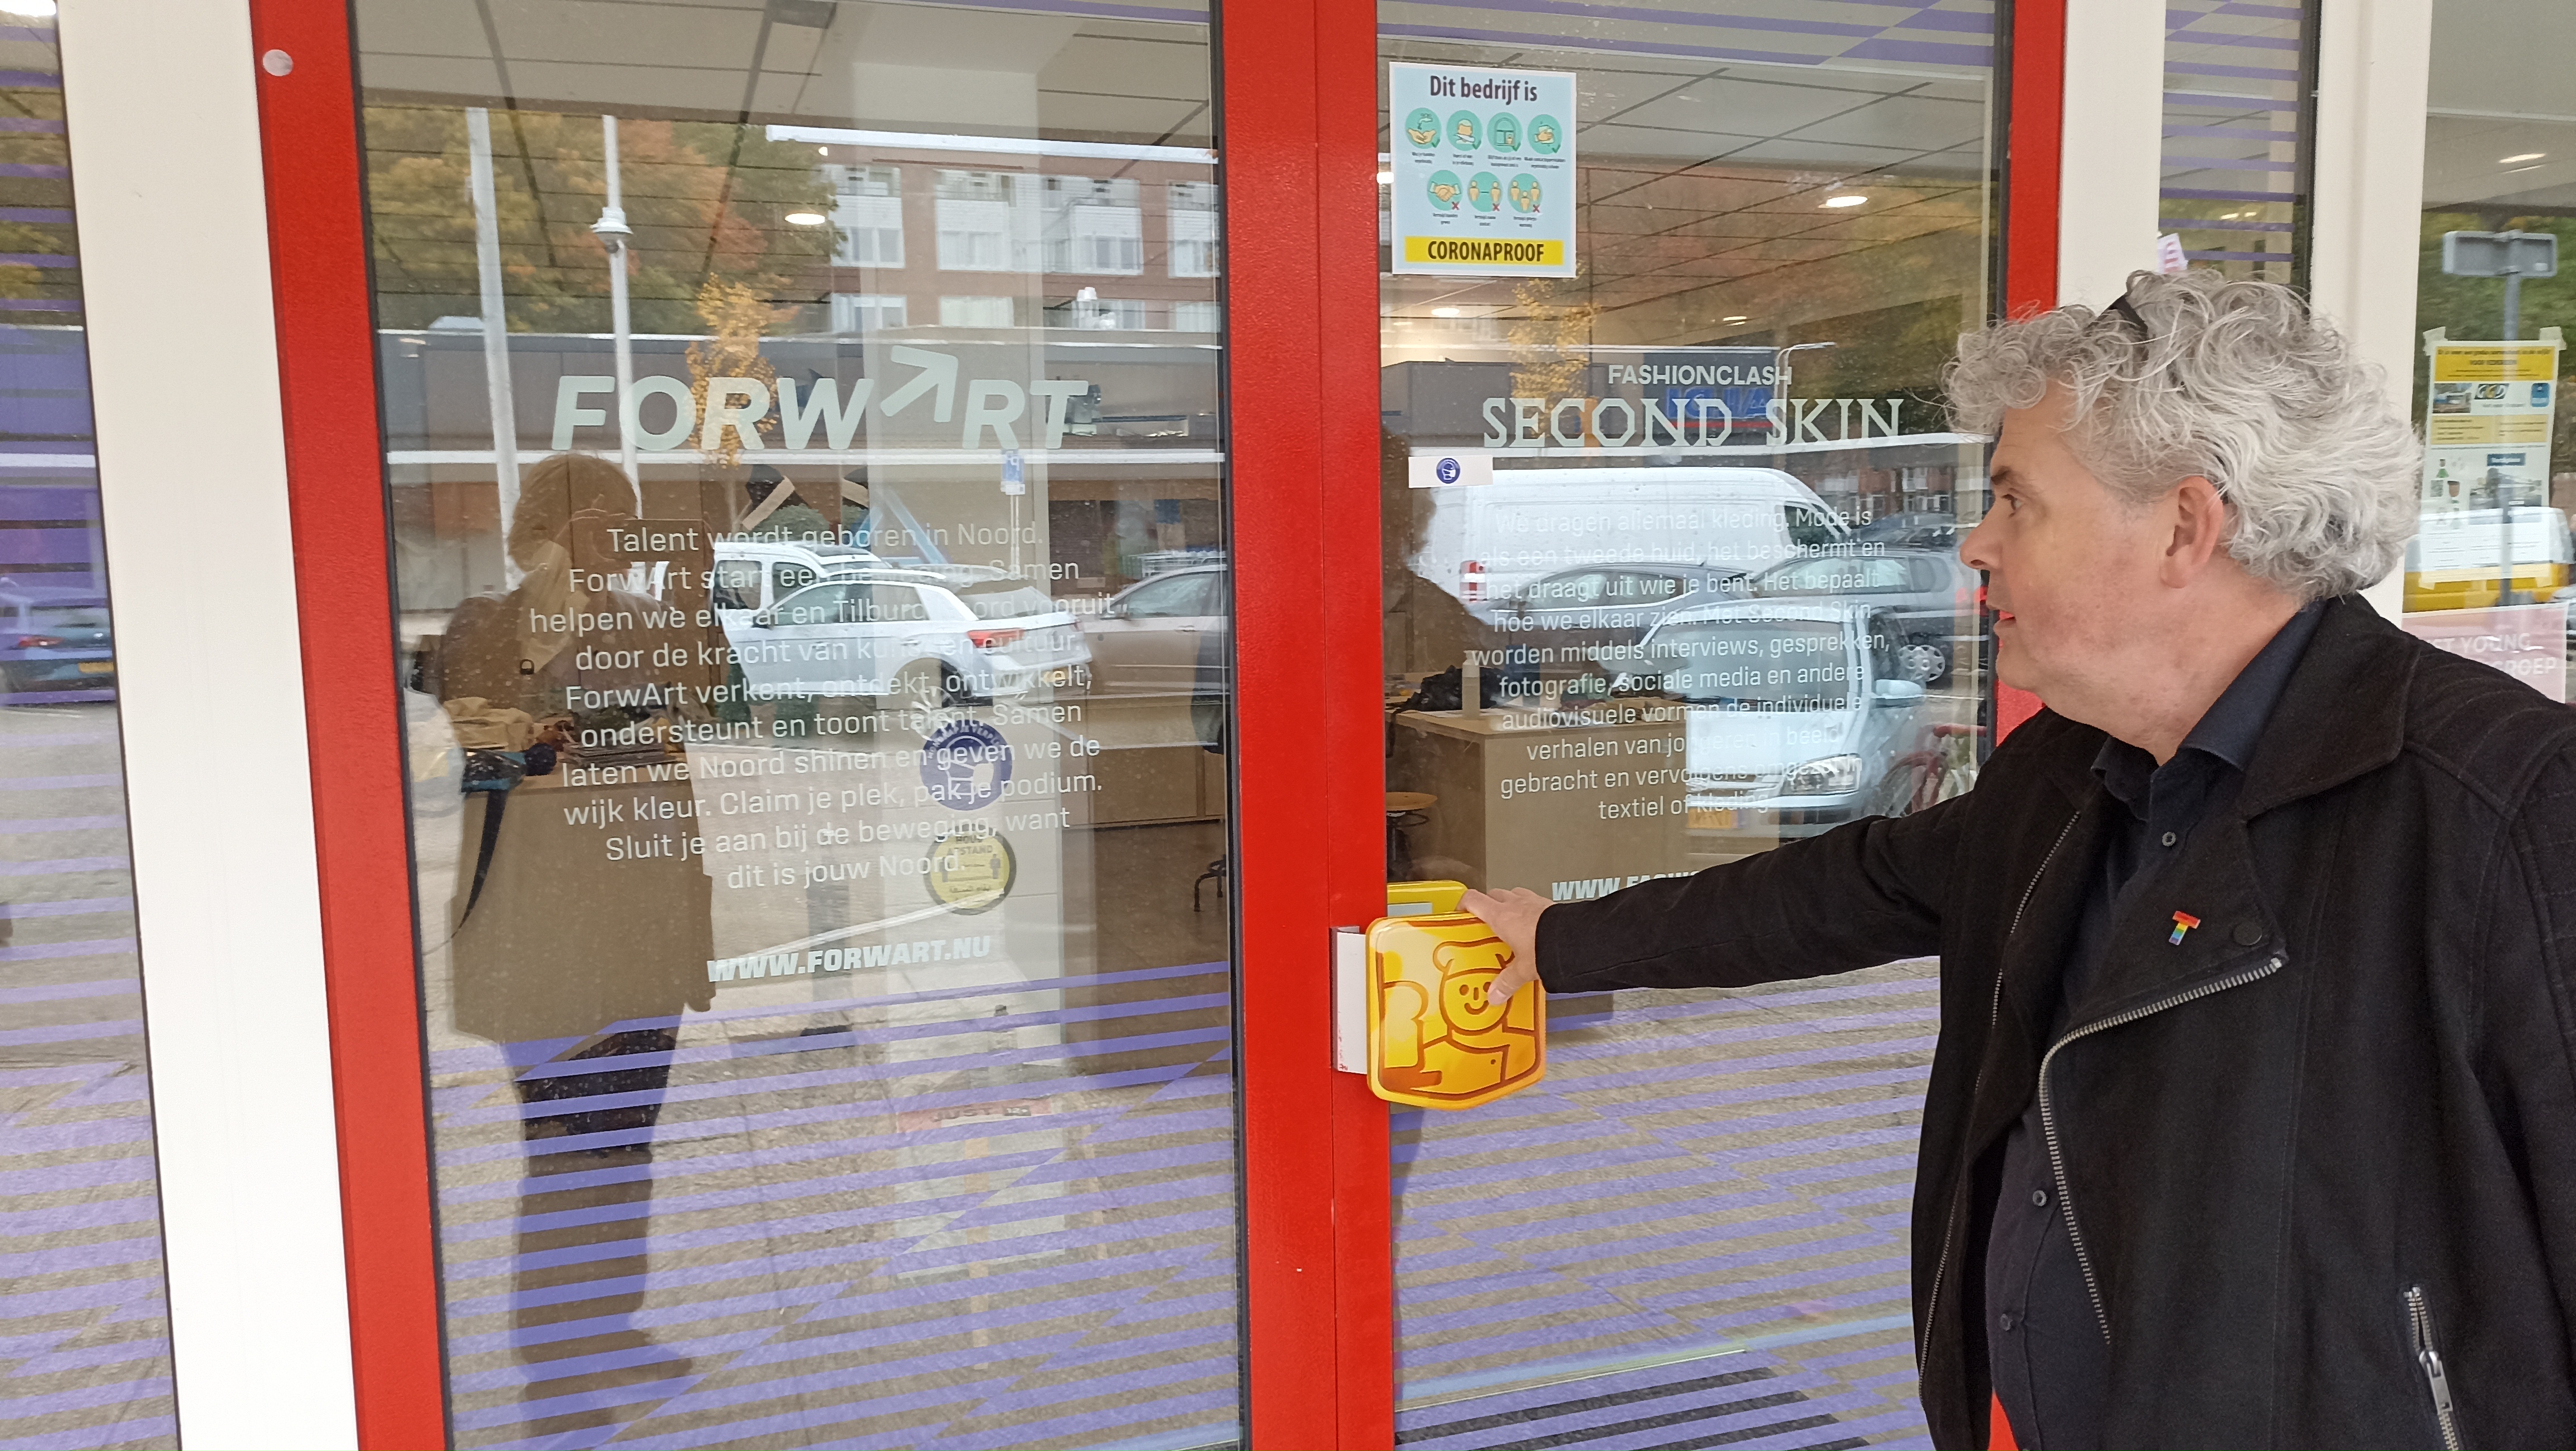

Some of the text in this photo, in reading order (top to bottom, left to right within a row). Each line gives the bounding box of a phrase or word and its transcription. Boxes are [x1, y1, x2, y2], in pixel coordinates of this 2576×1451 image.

[1430, 75, 1537, 105] Dit bedrijf is
[1428, 241, 1544, 262] CORONAPROOF
[1609, 364, 1792, 386] FASHIONCLASH
[1483, 398, 1904, 447] SECOND SKIN
[607, 523, 1042, 553] Talent wordt geboren in Noord.
[1496, 507, 1871, 537] We dragen allemaal kleding. Mode is
[1481, 539, 1885, 567] als een tweede huid, het beschermt en
[569, 567, 692, 592] ForwArt
[701, 565, 770, 589] start
[990, 560, 1079, 581] Samen
[1486, 568, 1879, 602] het draagt uit wie je bent. Het bepaalt
[530, 608, 633, 637] helpen
[642, 611, 686, 629] we
[695, 603, 780, 629] elkaar
[793, 606, 825, 624] en
[1022, 592, 1115, 616] vooruit
[1494, 612, 1534, 632] hoe
[1541, 615, 1572, 630] we
[1580, 609, 1643, 629] elkaar
[1704, 605, 1742, 625] Met
[1748, 601, 1823, 623] Second
[1831, 600, 1871, 620] Skin
[575, 645, 643, 670] door
[653, 643, 687, 666] de
[698, 639, 790, 665] kracht
[801, 642, 847, 661] van
[1472, 631, 1890, 666] worden middels interviews, gesprekken,
[565, 664, 1091, 710] ForwArt verkent, ontdekt, ontwikkelt,
[1500, 663, 1865, 700] fotografie, sociale media en andere
[580, 704, 1081, 747] ondersteunt en toont talent. Samen
[1502, 694, 1862, 730] audiovisuele vormen de individuele
[562, 735, 1100, 787] laten we Noord shinen en geven we de
[1526, 737, 1618, 760] verhalen
[1625, 739, 1661, 755] van
[1501, 770, 1598, 799] gebracht
[1605, 772, 1629, 787] en
[1636, 759, 1747, 786] vervolgens
[563, 772, 1102, 829] wijk kleur. Claim je plek, pak je podium.
[1598, 795, 1664, 820] textiel
[1671, 794, 1692, 815] of
[606, 808, 1070, 861] Sluit je aan bij de beweging, want
[947, 845, 993, 855] ASTAND
[728, 849, 965, 889] dit is jouw Noord.
[706, 935, 991, 982] WWW.FORWART.NU
